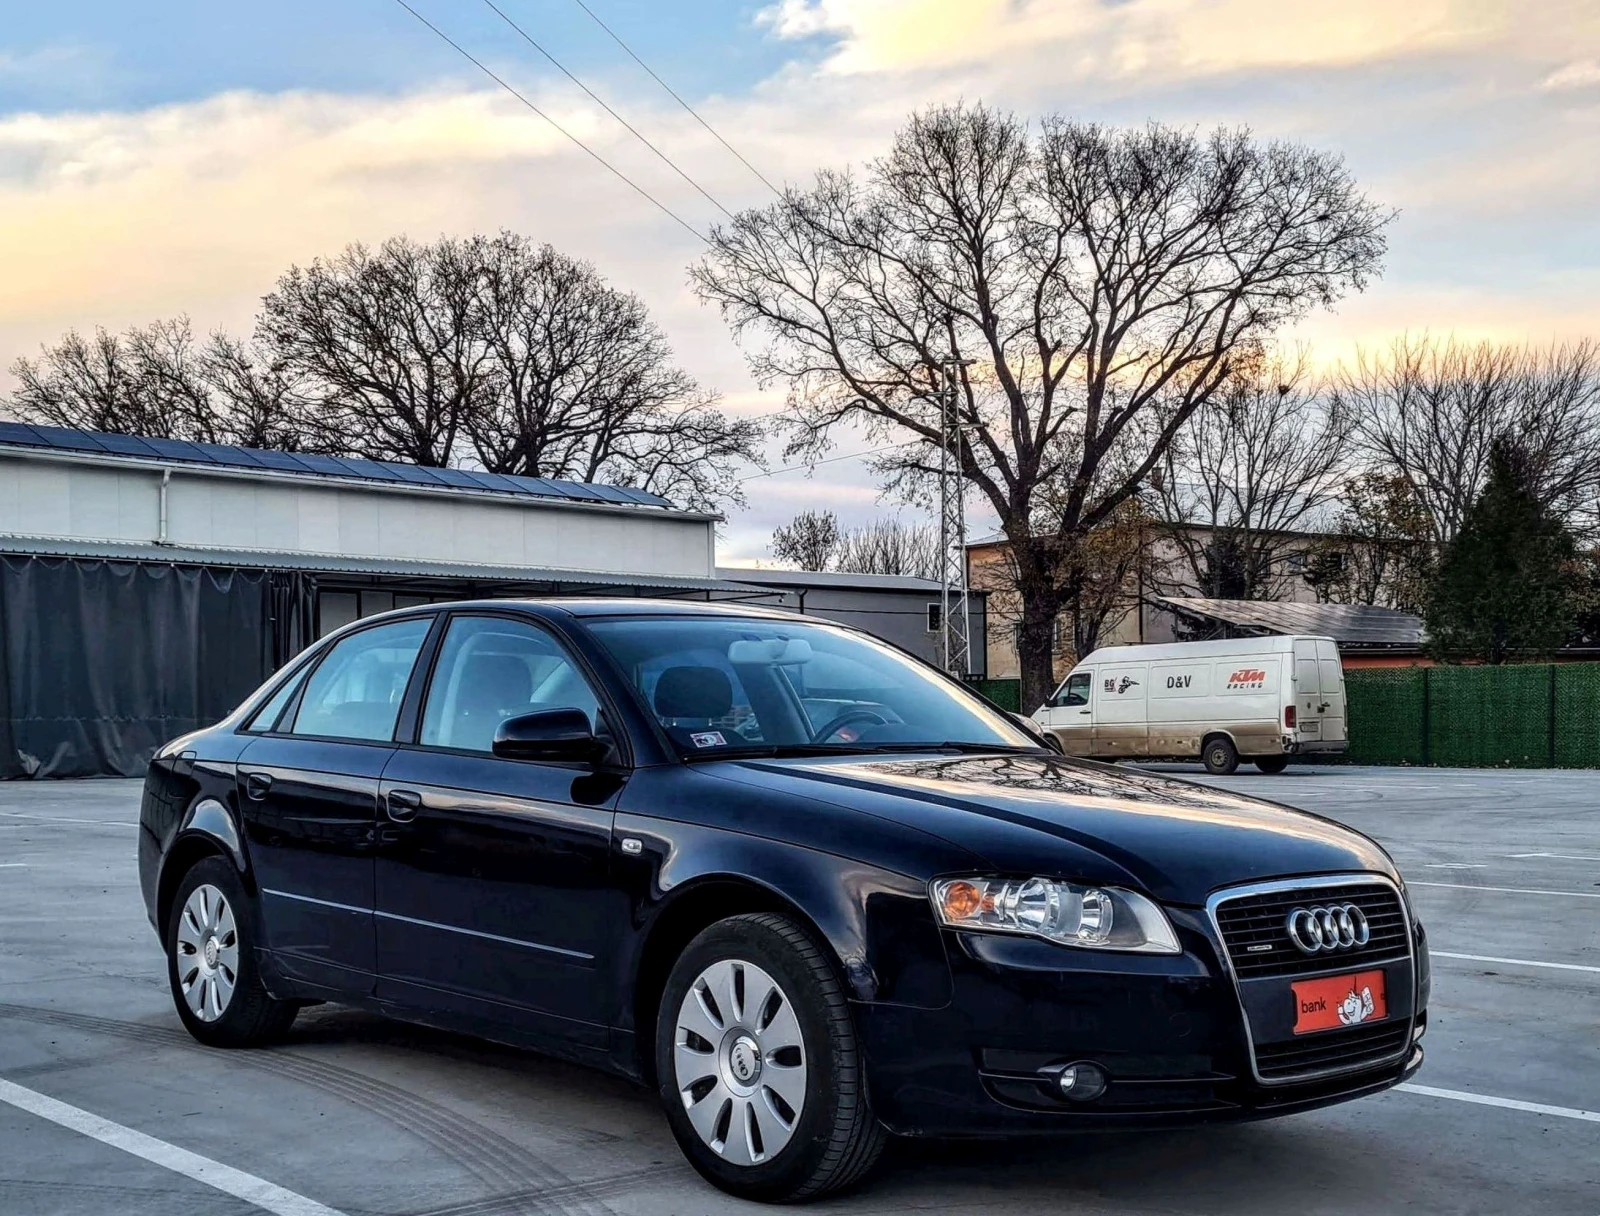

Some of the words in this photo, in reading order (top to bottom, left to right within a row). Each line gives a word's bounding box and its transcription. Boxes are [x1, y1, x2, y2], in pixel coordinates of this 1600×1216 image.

[1167, 675, 1192, 689] D&V
[1229, 669, 1266, 682] KTM
[1227, 682, 1263, 690] RACING
[1301, 996, 1327, 1014] bank
